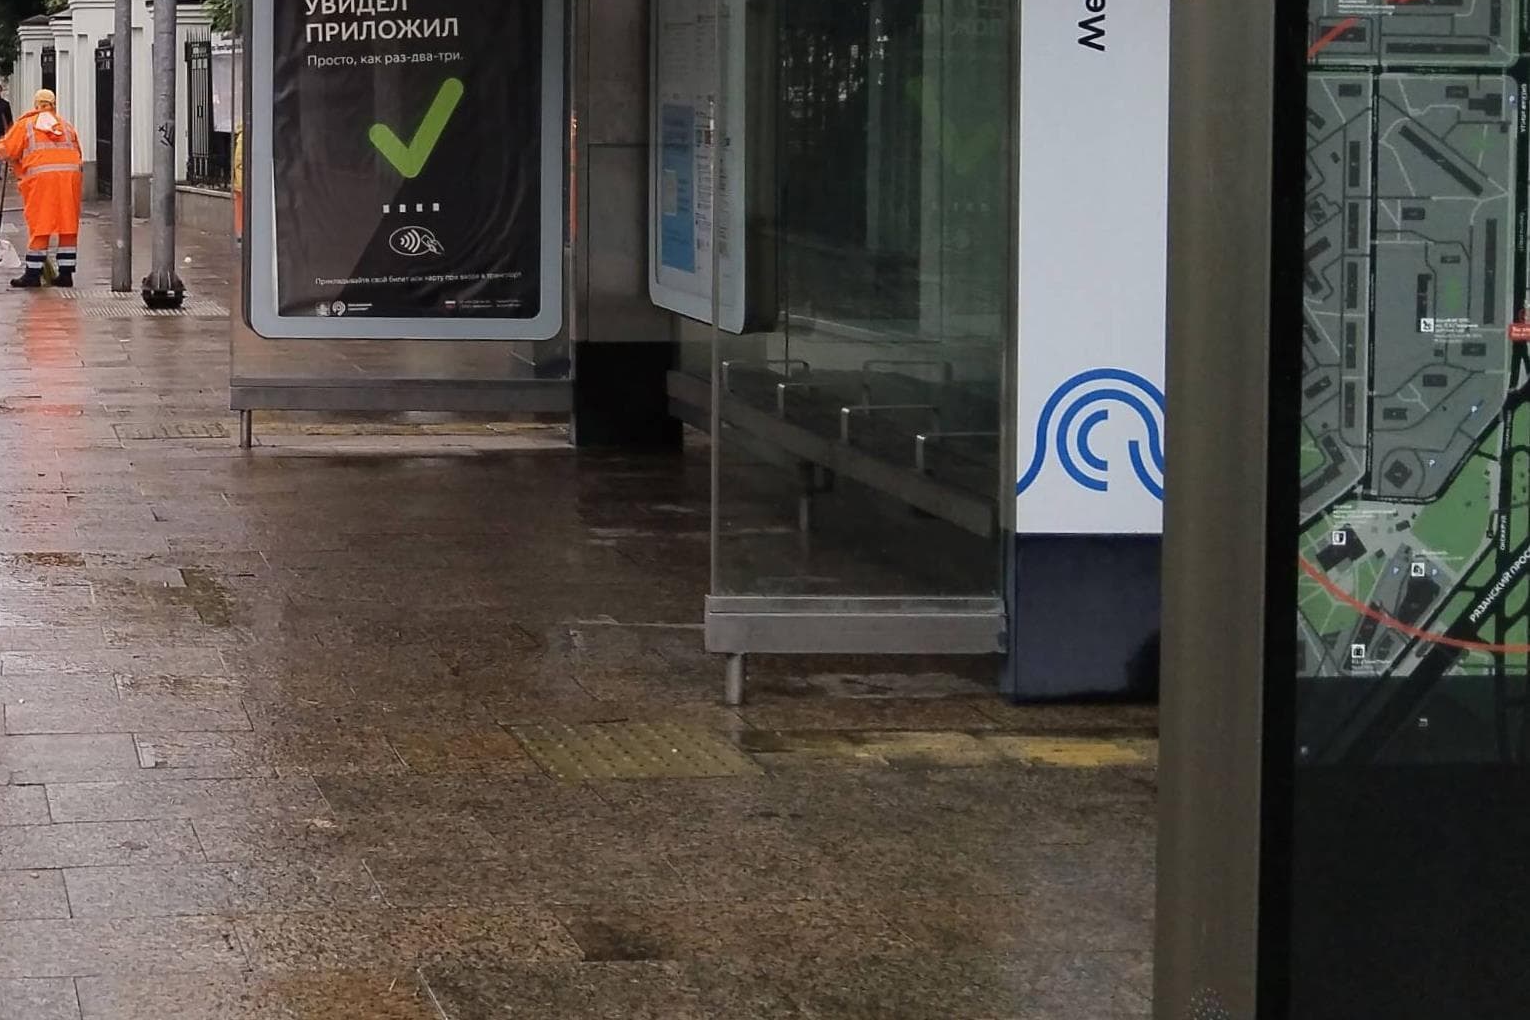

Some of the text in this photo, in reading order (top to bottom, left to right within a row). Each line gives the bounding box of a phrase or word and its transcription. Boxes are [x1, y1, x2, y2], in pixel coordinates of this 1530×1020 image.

[306, 17, 459, 43] ПРИЛОЖИЛ
[307, 52, 464, 68] Просто, как раз-два-три.
[1470, 571, 1512, 623] РЯЗАНСКИЙ
